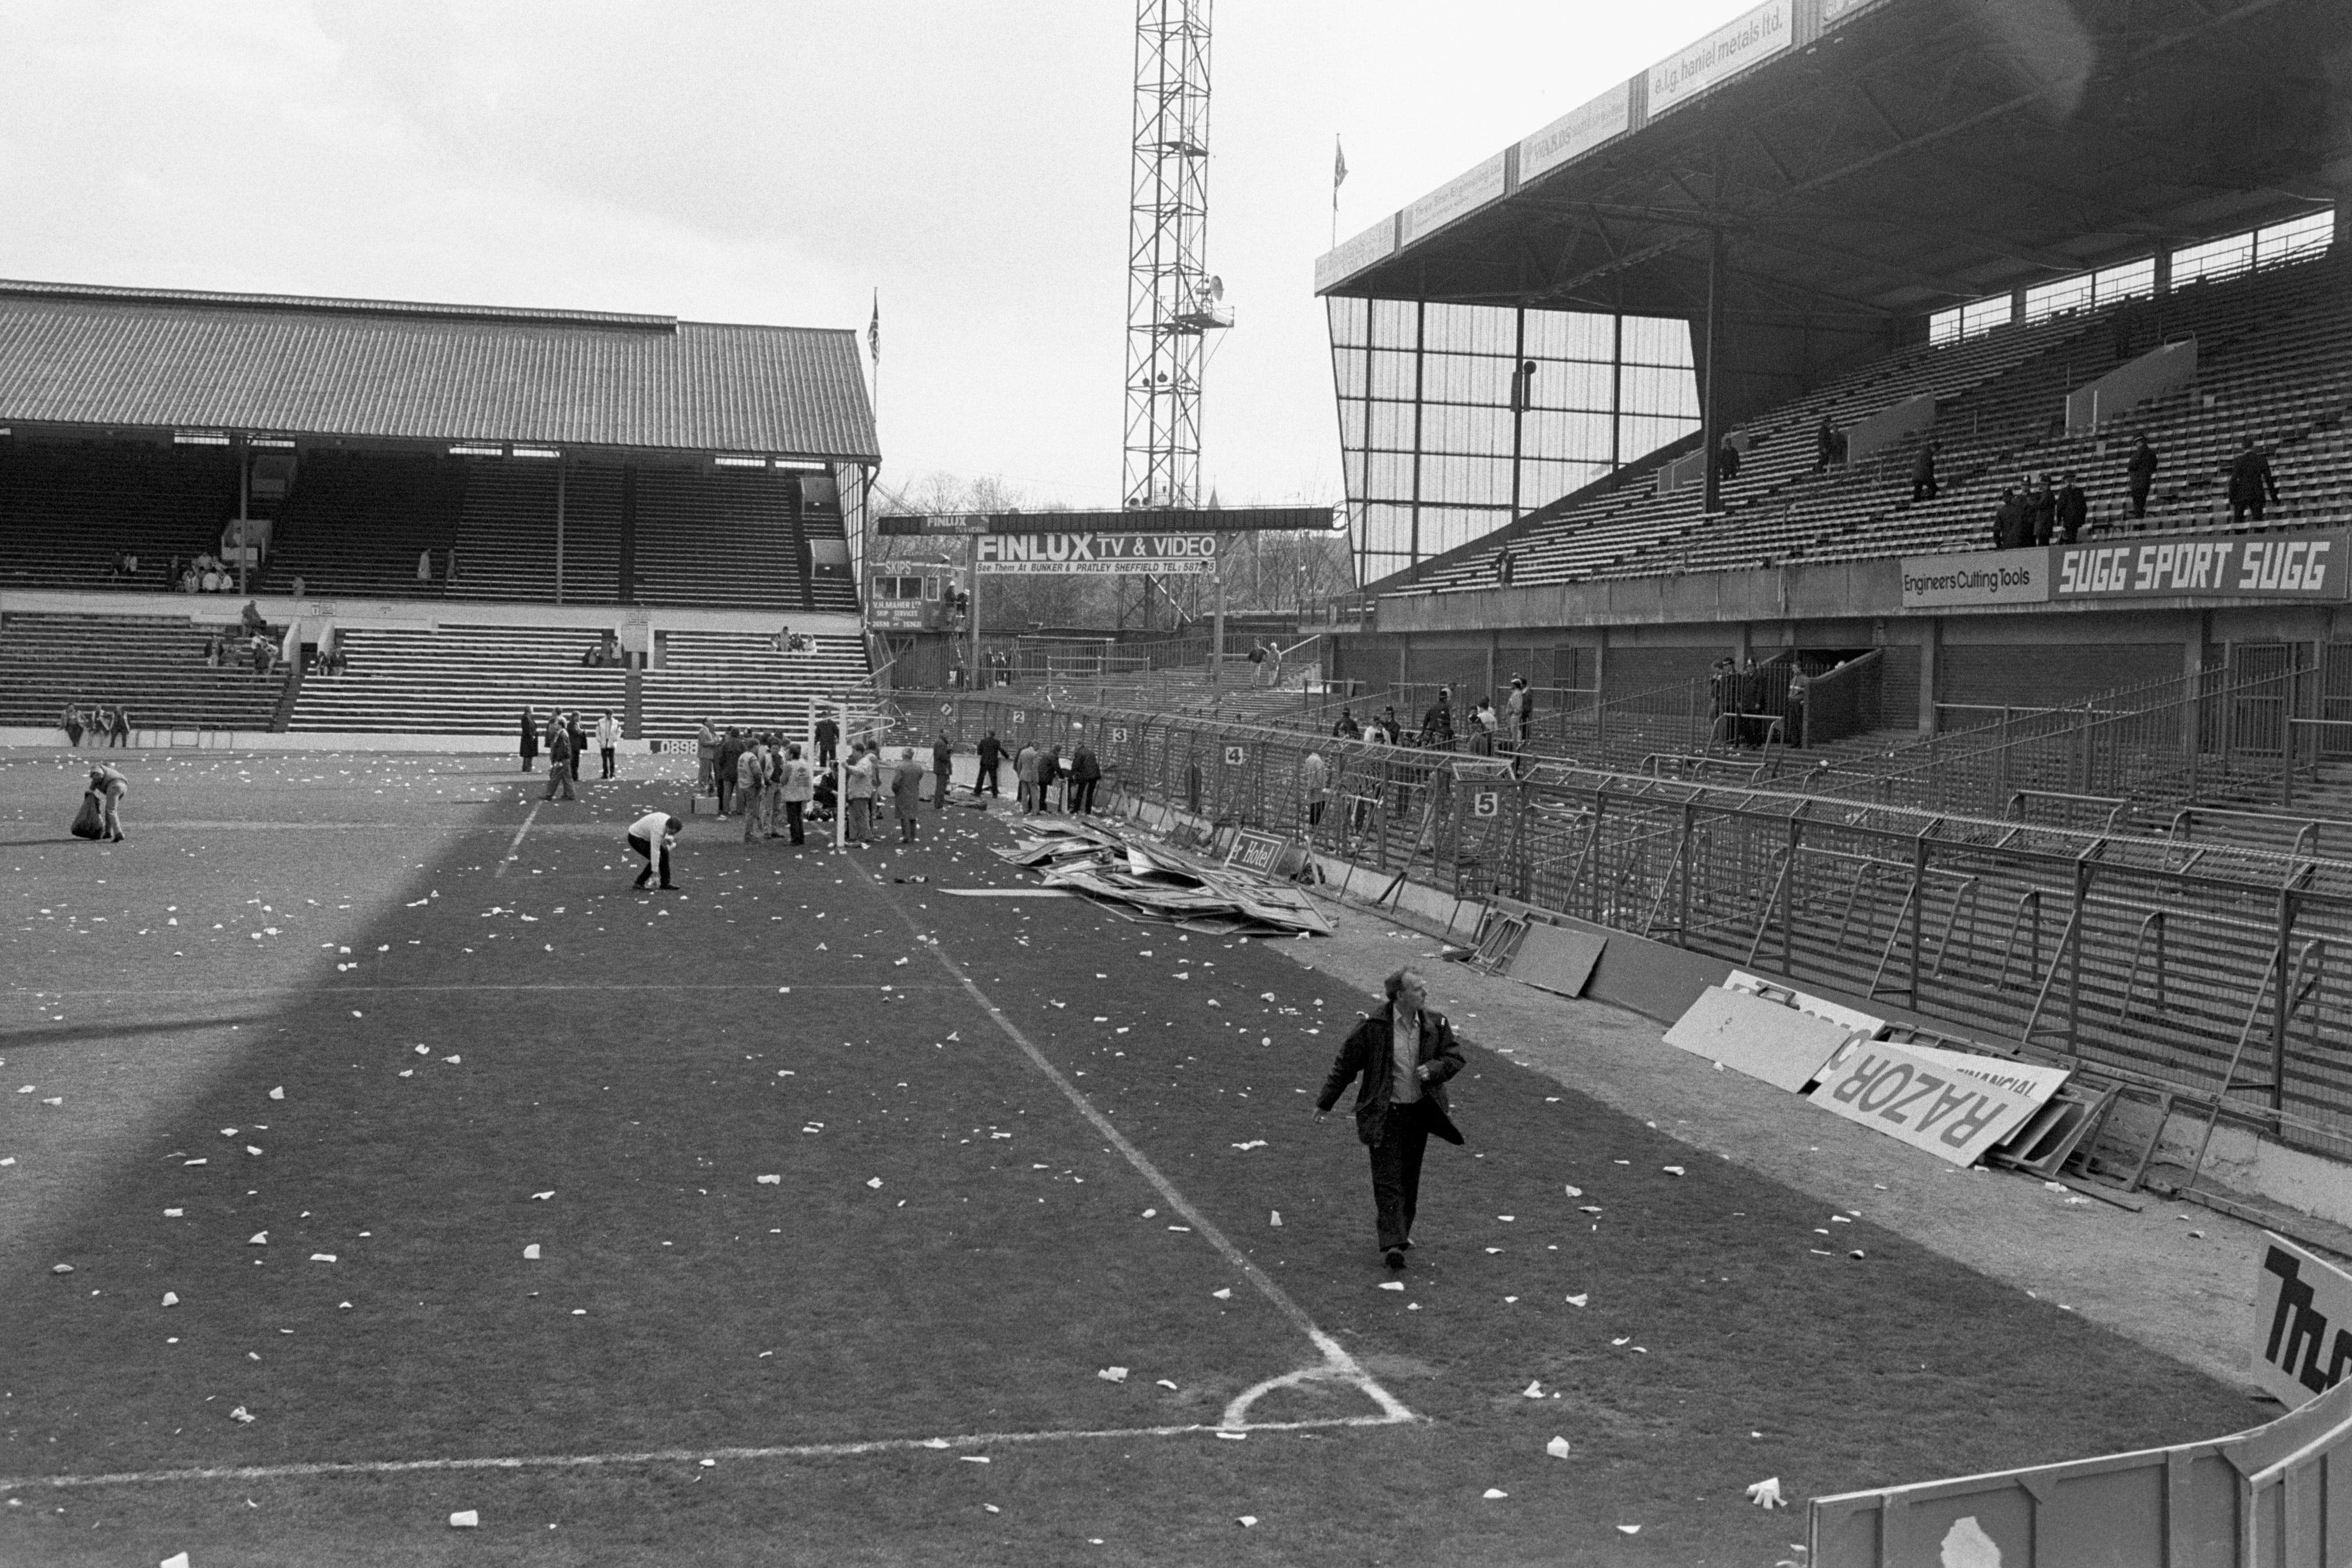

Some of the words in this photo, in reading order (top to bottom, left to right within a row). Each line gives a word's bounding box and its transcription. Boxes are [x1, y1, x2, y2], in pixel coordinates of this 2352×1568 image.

[1655, 68, 1679, 94] e.l.g.
[1681, 40, 1715, 81] haniel
[1718, 20, 1759, 61] metals
[1762, 7, 1783, 37] ltd.
[927, 516, 966, 527] FINLUX
[977, 535, 1094, 561] FINLUX
[1097, 537, 1124, 556] TV
[1134, 537, 1147, 556] &
[1154, 537, 1216, 556] VIDEO
[885, 561, 911, 575] SKIPS
[977, 563, 991, 572] See
[995, 563, 1015, 572] Them
[1018, 563, 1027, 572] At
[1031, 563, 1063, 572] BUNKER
[1065, 563, 1070, 572] &
[1077, 563, 1111, 572] PRATLEY
[1115, 563, 1159, 572] SHEFFIELD
[2059, 548, 2130, 593] SUGG
[2134, 543, 2233, 590] SPORT
[2239, 541, 2330, 590] SUGG
[1904, 574, 1956, 595] Engineers
[1957, 570, 1997, 593] Cutting
[1999, 567, 2030, 586] Tools
[1016, 712, 1023, 722] 2
[1115, 729, 1125, 742] 3
[661, 741, 698, 754] 0898
[1228, 748, 1241, 764] 4
[1478, 794, 1494, 815] 5
[1242, 841, 1274, 868] Hotel
[1956, 1068, 2037, 1098] ANCIAL
[1833, 1054, 2009, 1148] RAZOR
